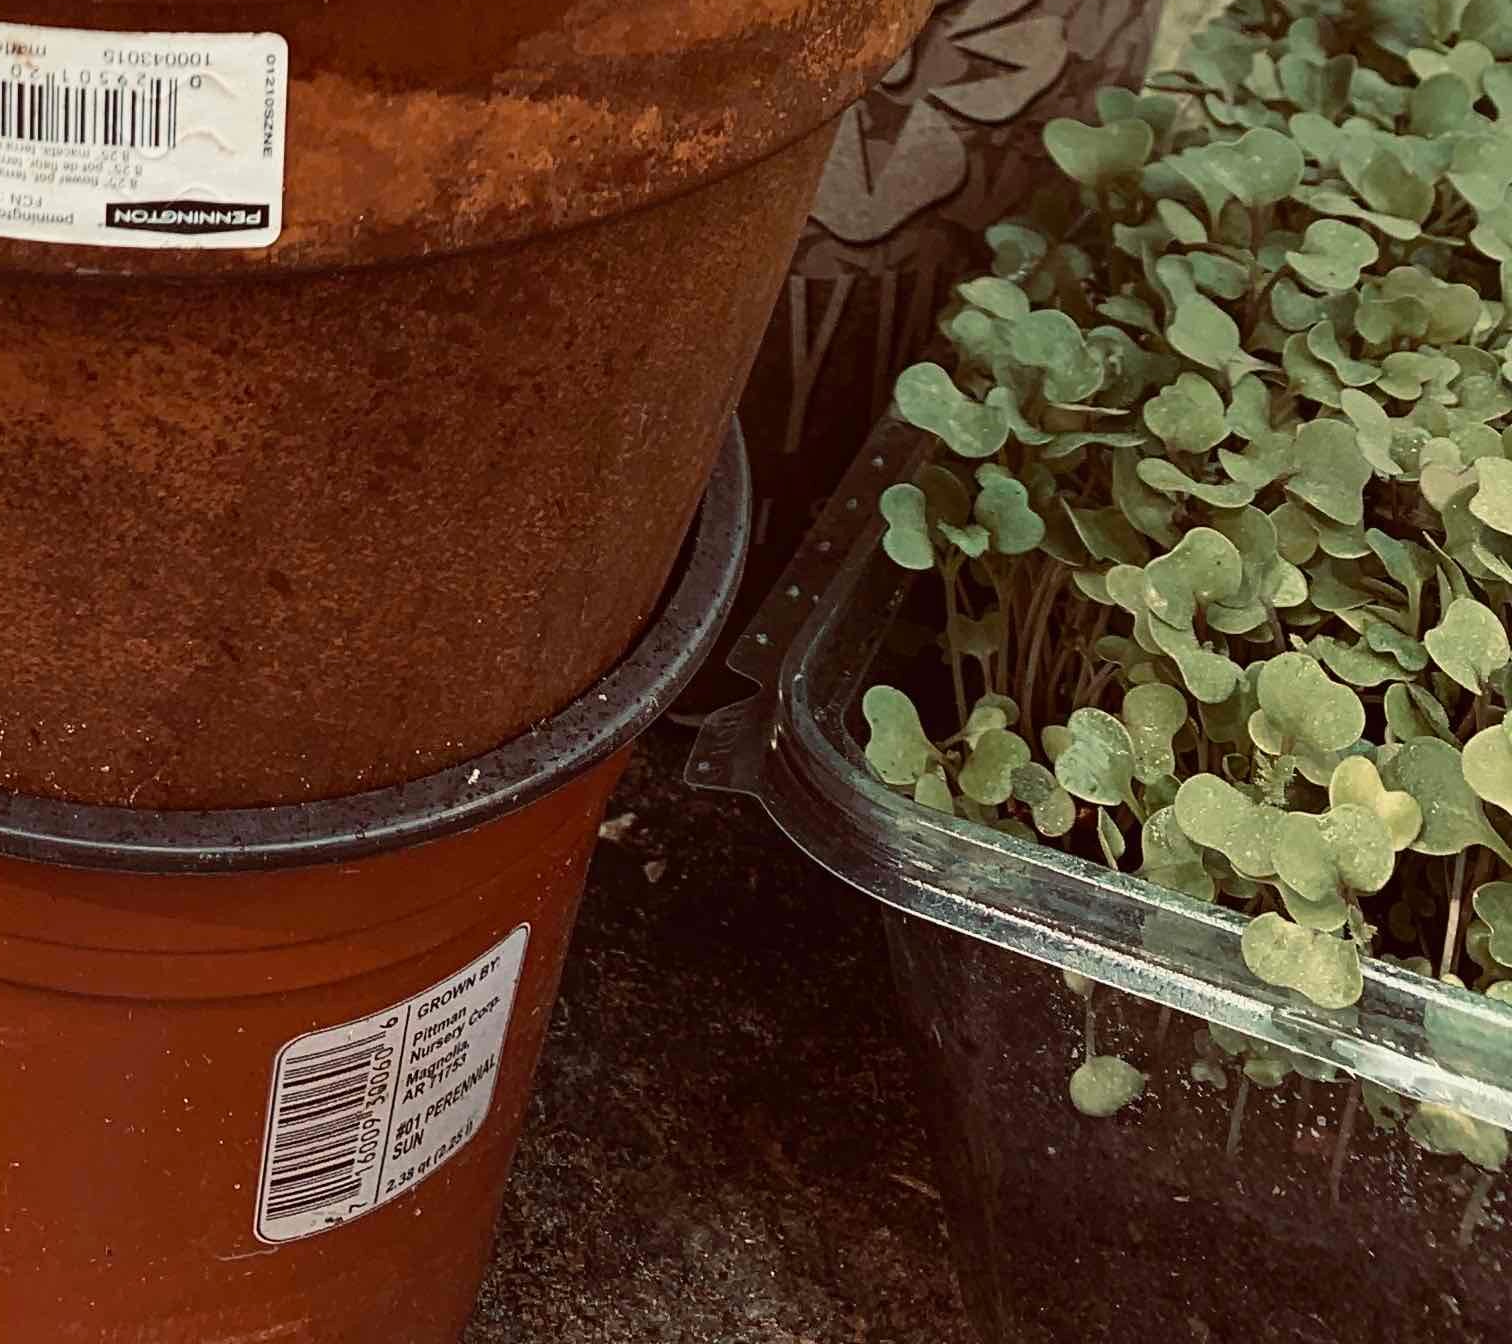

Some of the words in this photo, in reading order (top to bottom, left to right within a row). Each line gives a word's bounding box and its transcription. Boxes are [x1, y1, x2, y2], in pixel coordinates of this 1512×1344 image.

[113, 208, 263, 226] PENNINGTON
[417, 973, 477, 1020] GROWN
[409, 1021, 466, 1065] Nursery
[412, 1005, 468, 1048] Pittman
[395, 1112, 422, 1141] #01
[424, 1053, 497, 1124] PERENNIAL
[402, 1081, 426, 1105] AR
[392, 1127, 425, 1161] SUN
